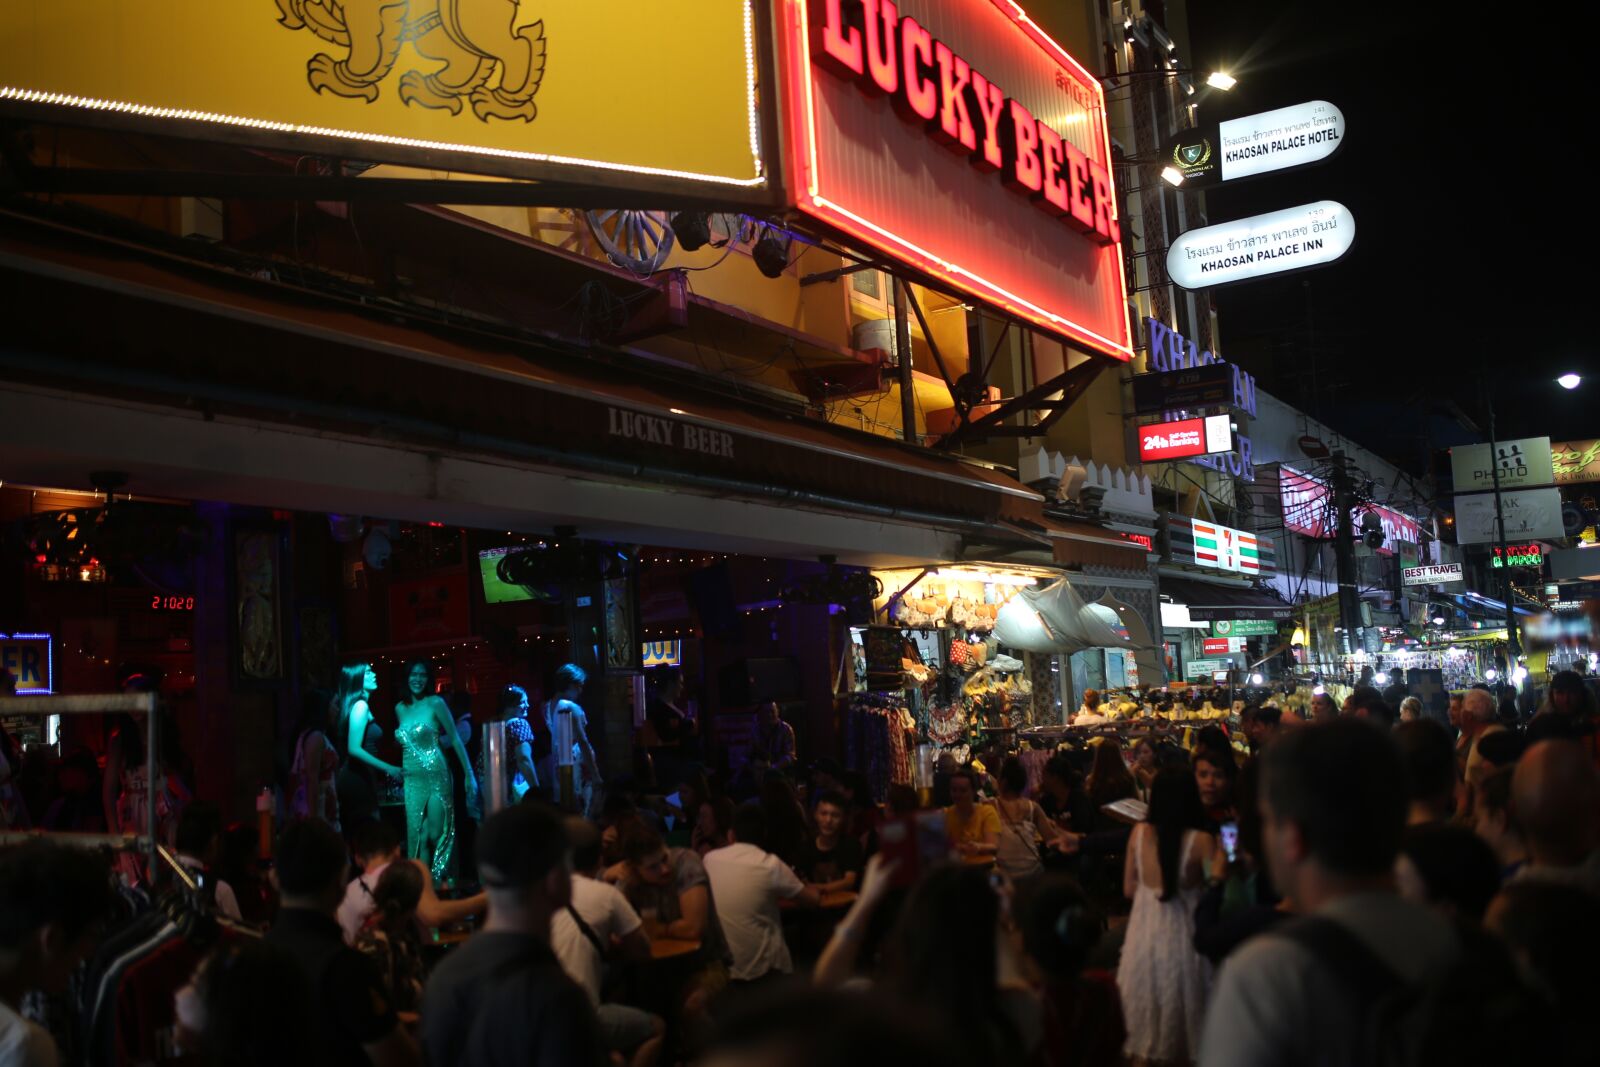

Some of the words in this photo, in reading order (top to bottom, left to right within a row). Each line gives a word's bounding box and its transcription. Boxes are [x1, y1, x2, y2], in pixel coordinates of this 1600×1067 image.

[824, 0, 1003, 168] LUCKY
[1011, 98, 1121, 243] BEER
[1188, 149, 1196, 158] K
[1225, 143, 1270, 163] KHAOSAN
[1272, 135, 1306, 153] PALACE
[1308, 127, 1339, 145] HOTEL
[1201, 253, 1254, 272] KHAOSAN
[1257, 244, 1299, 262] PALACE
[1303, 238, 1323, 252] INN
[608, 407, 675, 446] LUCKY
[682, 423, 735, 458] BEER
[1404, 567, 1426, 578] BEST
[1428, 564, 1462, 576] TRAVEL
